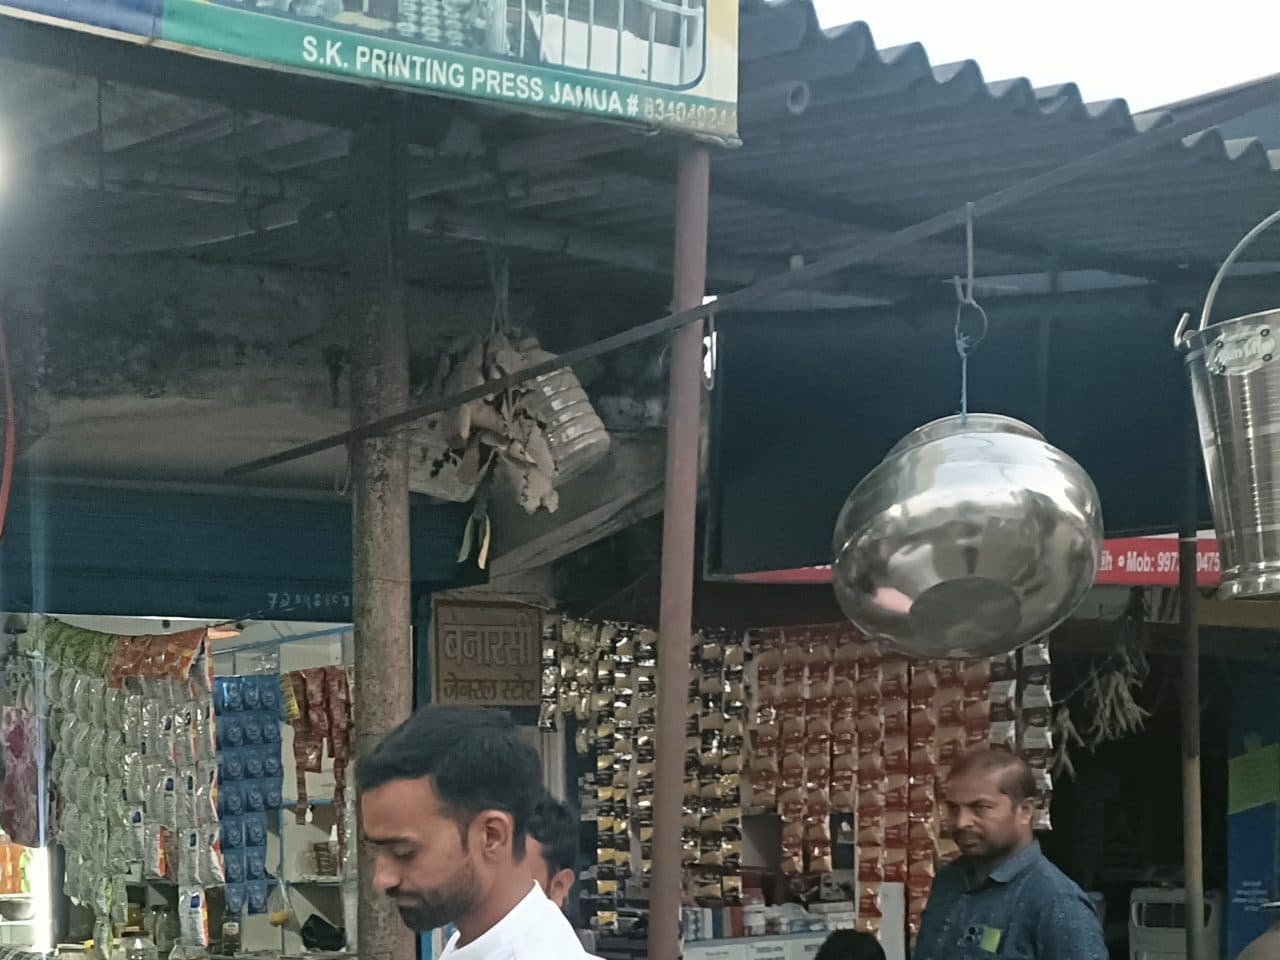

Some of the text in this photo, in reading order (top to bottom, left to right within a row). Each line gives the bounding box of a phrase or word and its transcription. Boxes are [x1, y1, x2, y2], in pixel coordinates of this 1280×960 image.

[302, 36, 348, 68] S.K.
[355, 45, 465, 89] PRINTING
[471, 66, 544, 101] PRESS
[549, 81, 623, 115] JAMUA
[1126, 551, 1155, 572] Mob:
